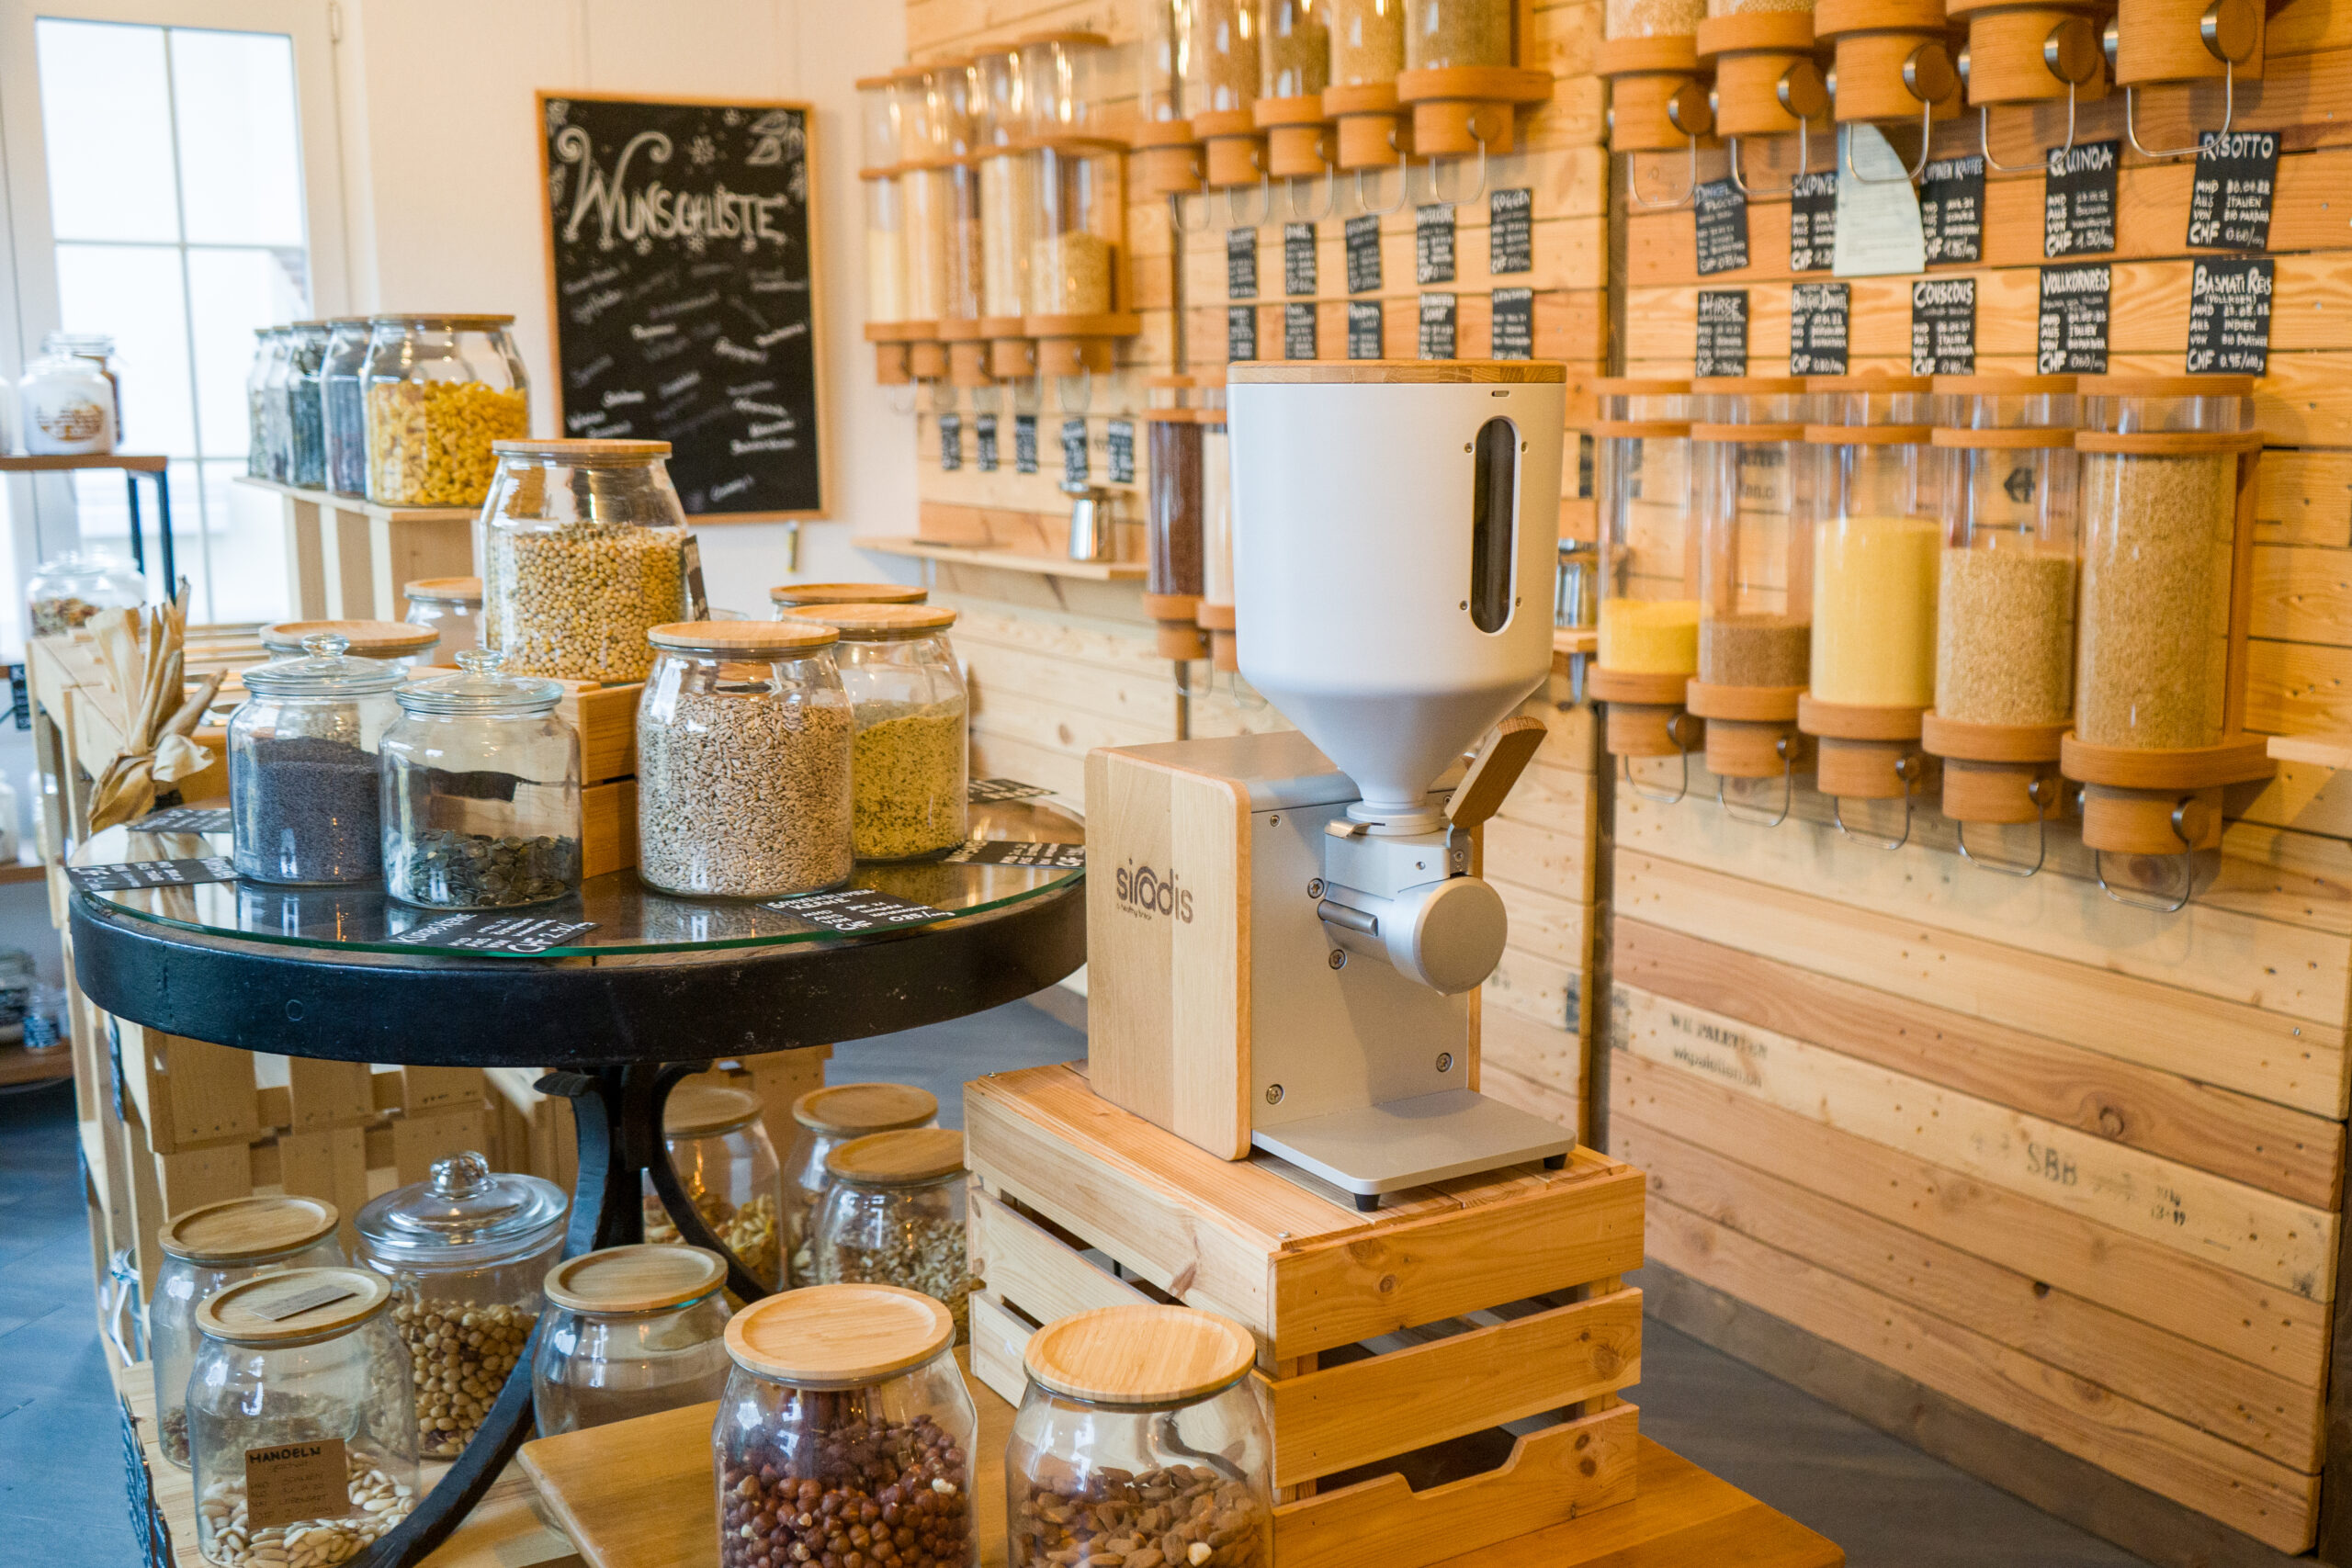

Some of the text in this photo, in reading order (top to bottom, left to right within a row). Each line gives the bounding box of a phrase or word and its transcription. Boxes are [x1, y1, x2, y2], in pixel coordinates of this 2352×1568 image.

[2202, 133, 2274, 161] RISOTTO
[2050, 145, 2113, 177] QUINOA
[2196, 179, 2219, 193] MHD
[1492, 191, 1532, 213] ROGGEN
[2194, 194, 2262, 208] AUS ITALIEN
[2193, 208, 2212, 220] VON
[2223, 209, 2238, 221] BIO
[2189, 220, 2221, 244] CHF
[2046, 230, 2073, 257] CHF
[1792, 248, 1813, 272] CHF
[2041, 268, 2110, 297] VOLLKORNREIS
[2194, 265, 2272, 297] BASMATI REIS
[1700, 293, 1742, 316] HIRSE
[1914, 281, 1973, 309] COUSCOUS
[2192, 303, 2214, 317] MHD
[2190, 319, 2256, 332] AUS INDIEN
[2190, 333, 2208, 346] VON
[1792, 353, 1812, 374] CHF
[1913, 356, 1936, 377] CHF
[2040, 350, 2066, 374] CHF
[2188, 349, 2215, 371] CHF
[835, 919, 874, 931] CHF
[506, 936, 553, 953] CHF
